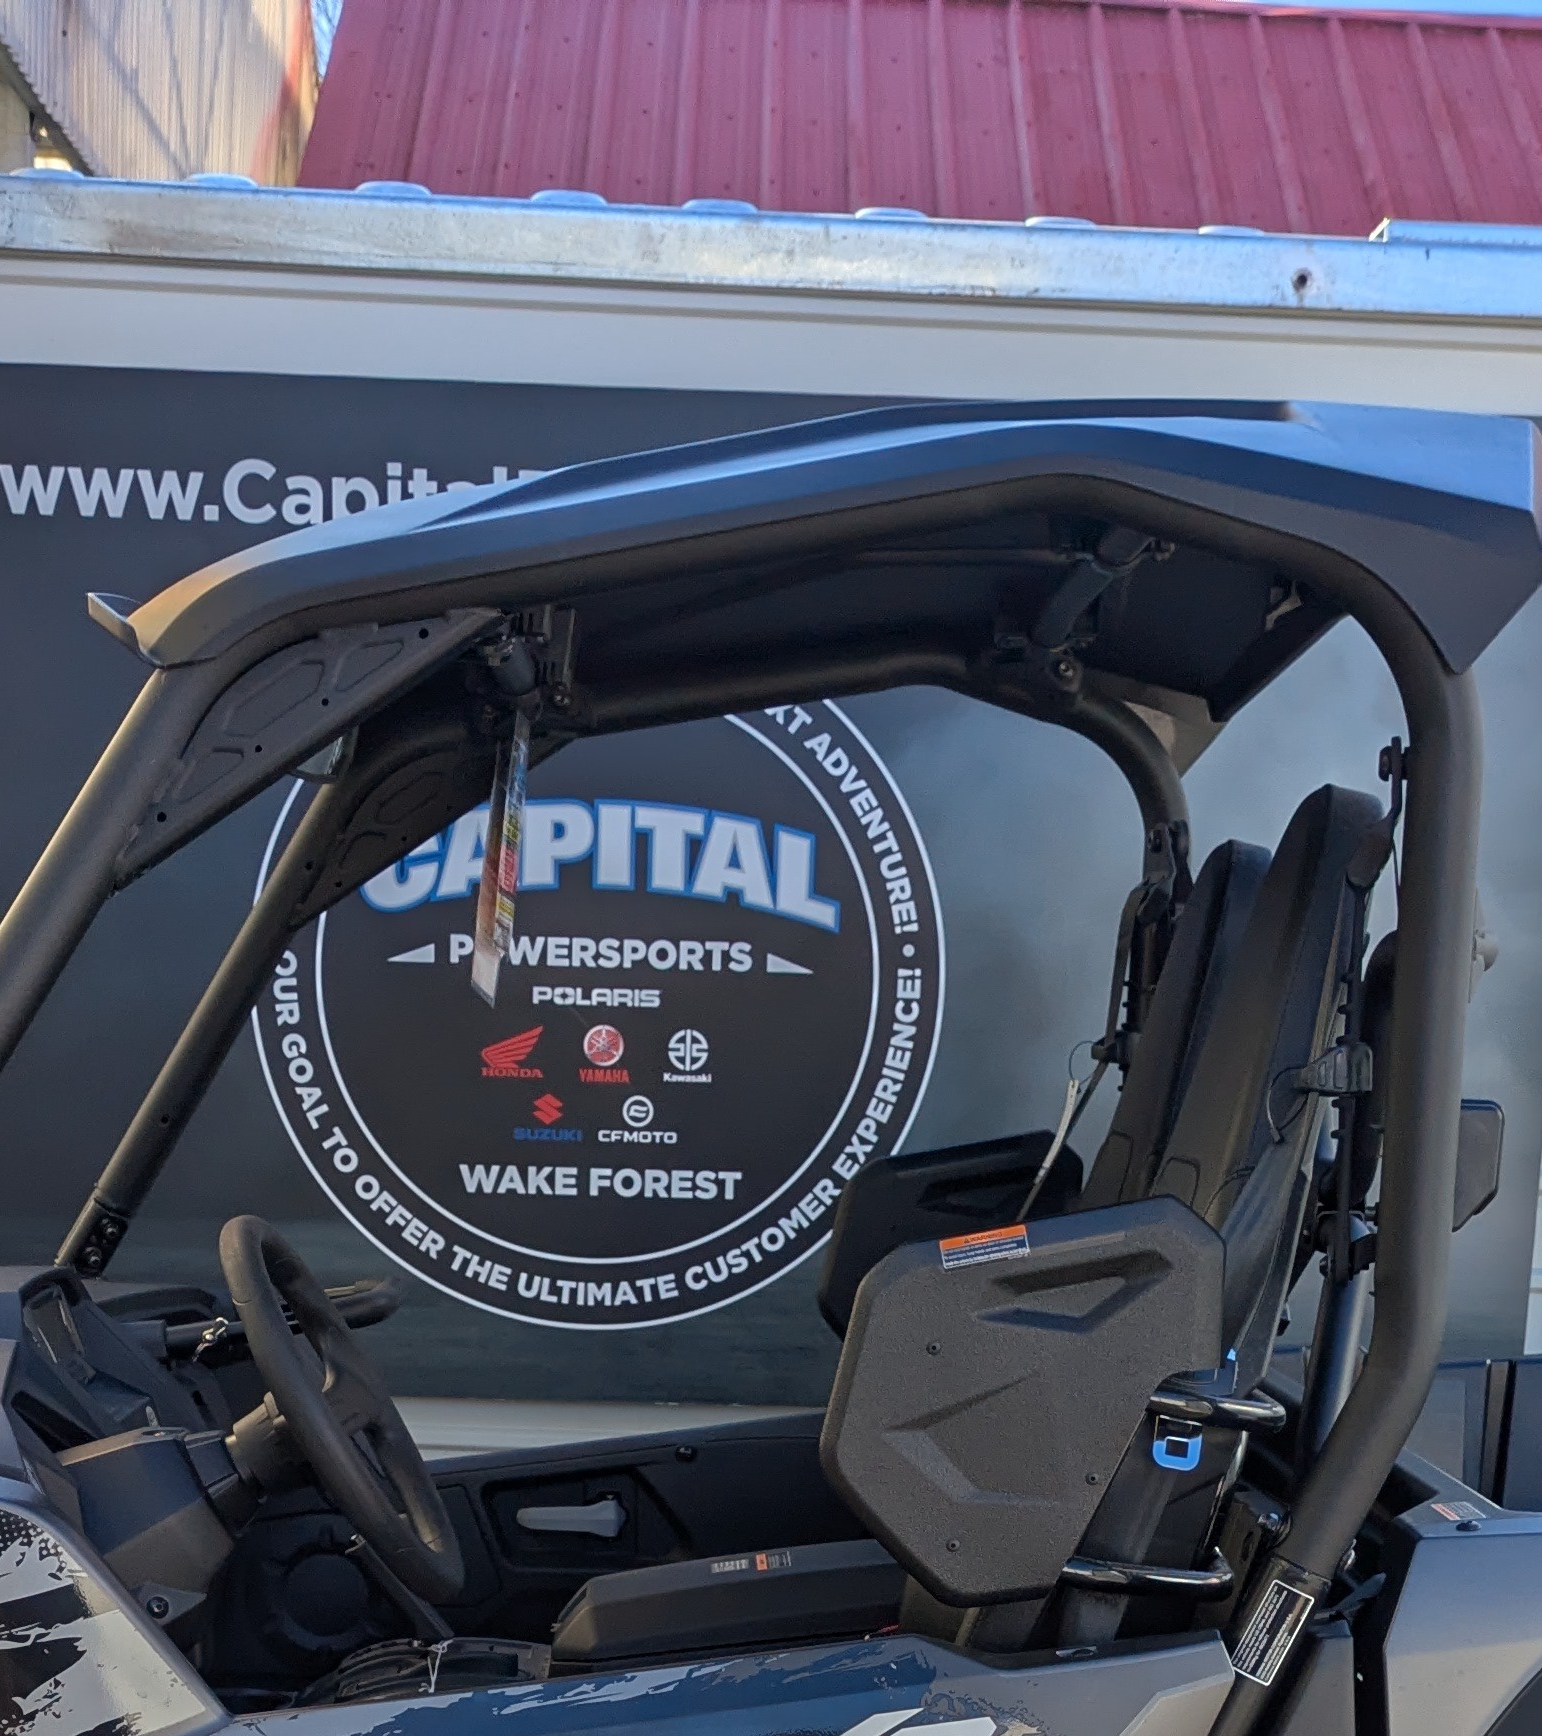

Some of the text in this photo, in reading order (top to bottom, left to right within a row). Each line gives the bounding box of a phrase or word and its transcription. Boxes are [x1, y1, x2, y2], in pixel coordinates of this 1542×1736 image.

[803, 732, 919, 935] ADVENTURE!
[449, 934, 753, 972] PWERSPORTS
[532, 986, 663, 1008] POLARIS
[481, 1067, 544, 1079] HONDA
[579, 1068, 631, 1083] YAMAHA
[663, 1072, 712, 1084] Kawasaki
[281, 1032, 330, 1130] GOAL
[321, 1126, 359, 1173] TO
[355, 1174, 446, 1260] OFFER
[449, 1244, 511, 1292] THE
[516, 1272, 679, 1307] ULTIMATE
[684, 1177, 842, 1292] CUSTOMER
[832, 967, 922, 1181] EXPERIENCE!
[513, 1127, 583, 1142] SUZUKI
[597, 1129, 678, 1144] CFMOTO
[459, 1164, 743, 1200] WAKE FOREST
